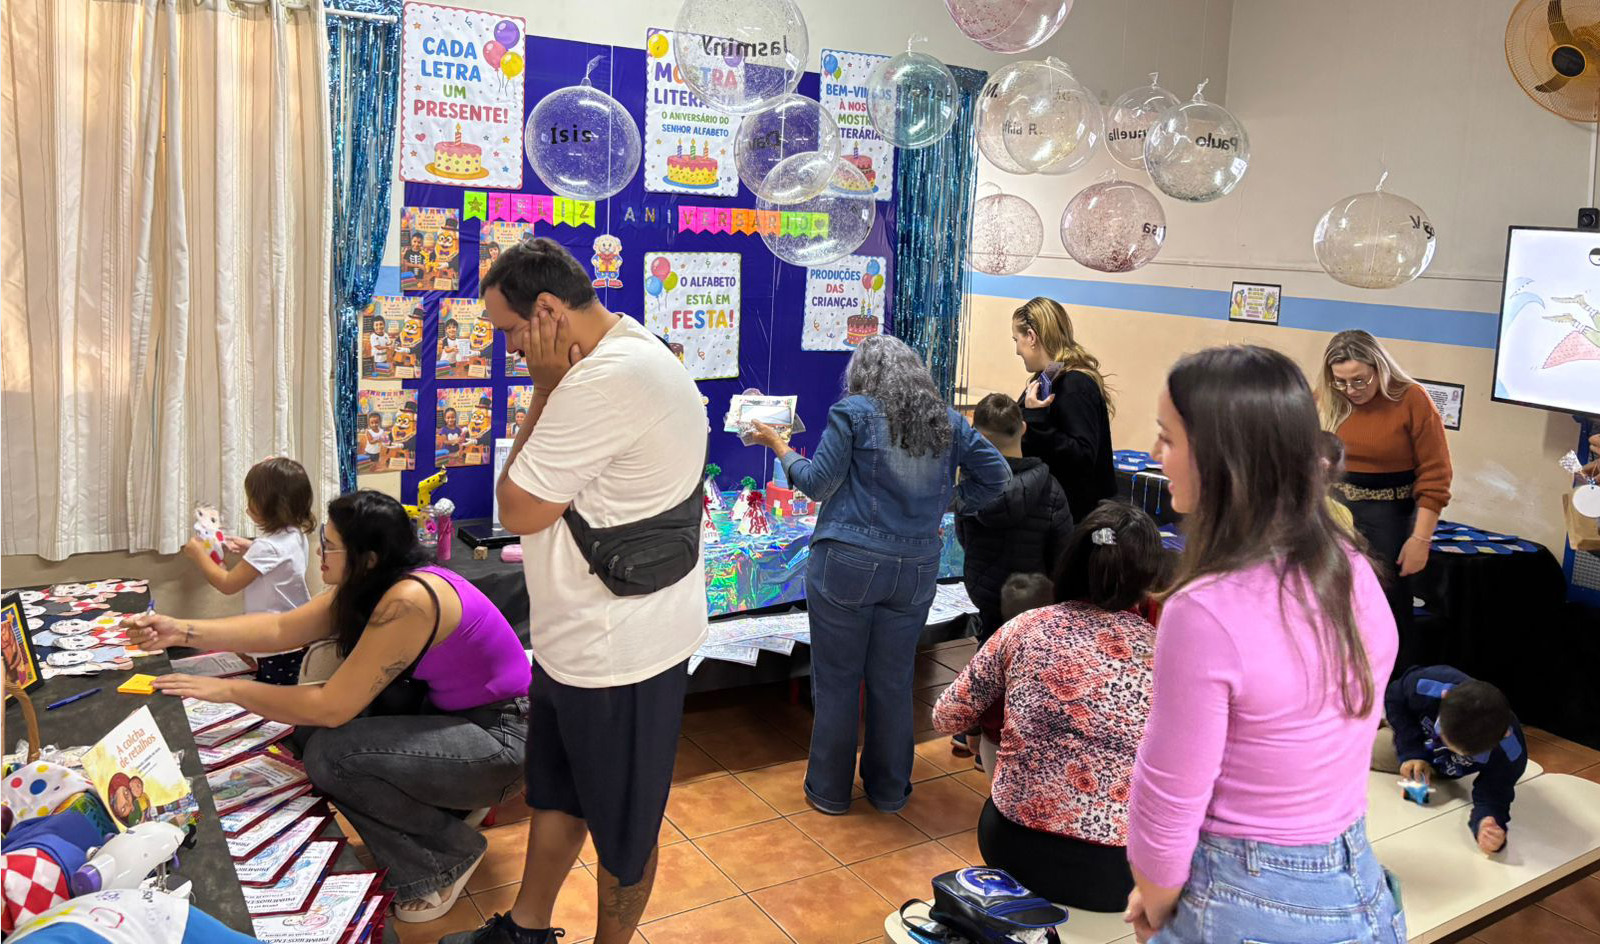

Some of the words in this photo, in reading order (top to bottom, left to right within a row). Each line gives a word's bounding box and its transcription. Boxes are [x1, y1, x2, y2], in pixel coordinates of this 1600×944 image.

[422, 36, 477, 60] CADA
[420, 59, 482, 82] LETRA
[442, 83, 467, 99] UM
[826, 83, 892, 101] BEM-VINOS
[413, 99, 509, 124] PRESENTE!
[839, 98, 846, 111] À
[661, 112, 668, 120] O
[669, 111, 717, 124] ANIVERSÁRIO
[719, 116, 730, 125] DO
[838, 113, 873, 126] MOSTR
[551, 123, 593, 145] Ísis
[661, 124, 692, 134] SENHOR
[693, 126, 730, 137] ALFABETO
[494, 197, 590, 219] FELIZ
[680, 277, 688, 287] O
[690, 275, 736, 288] ALFABETO
[809, 267, 861, 281] PRODUÇÕES
[825, 283, 844, 294] DAS
[686, 291, 712, 305] ESTÁ
[715, 294, 730, 305] EM
[811, 296, 859, 310] CRIANÇAS
[672, 309, 734, 330] FESTA!
[116, 744, 124, 755] A
[123, 728, 146, 750] colcha
[119, 756, 130, 768] de
[128, 734, 156, 761] retalhos
